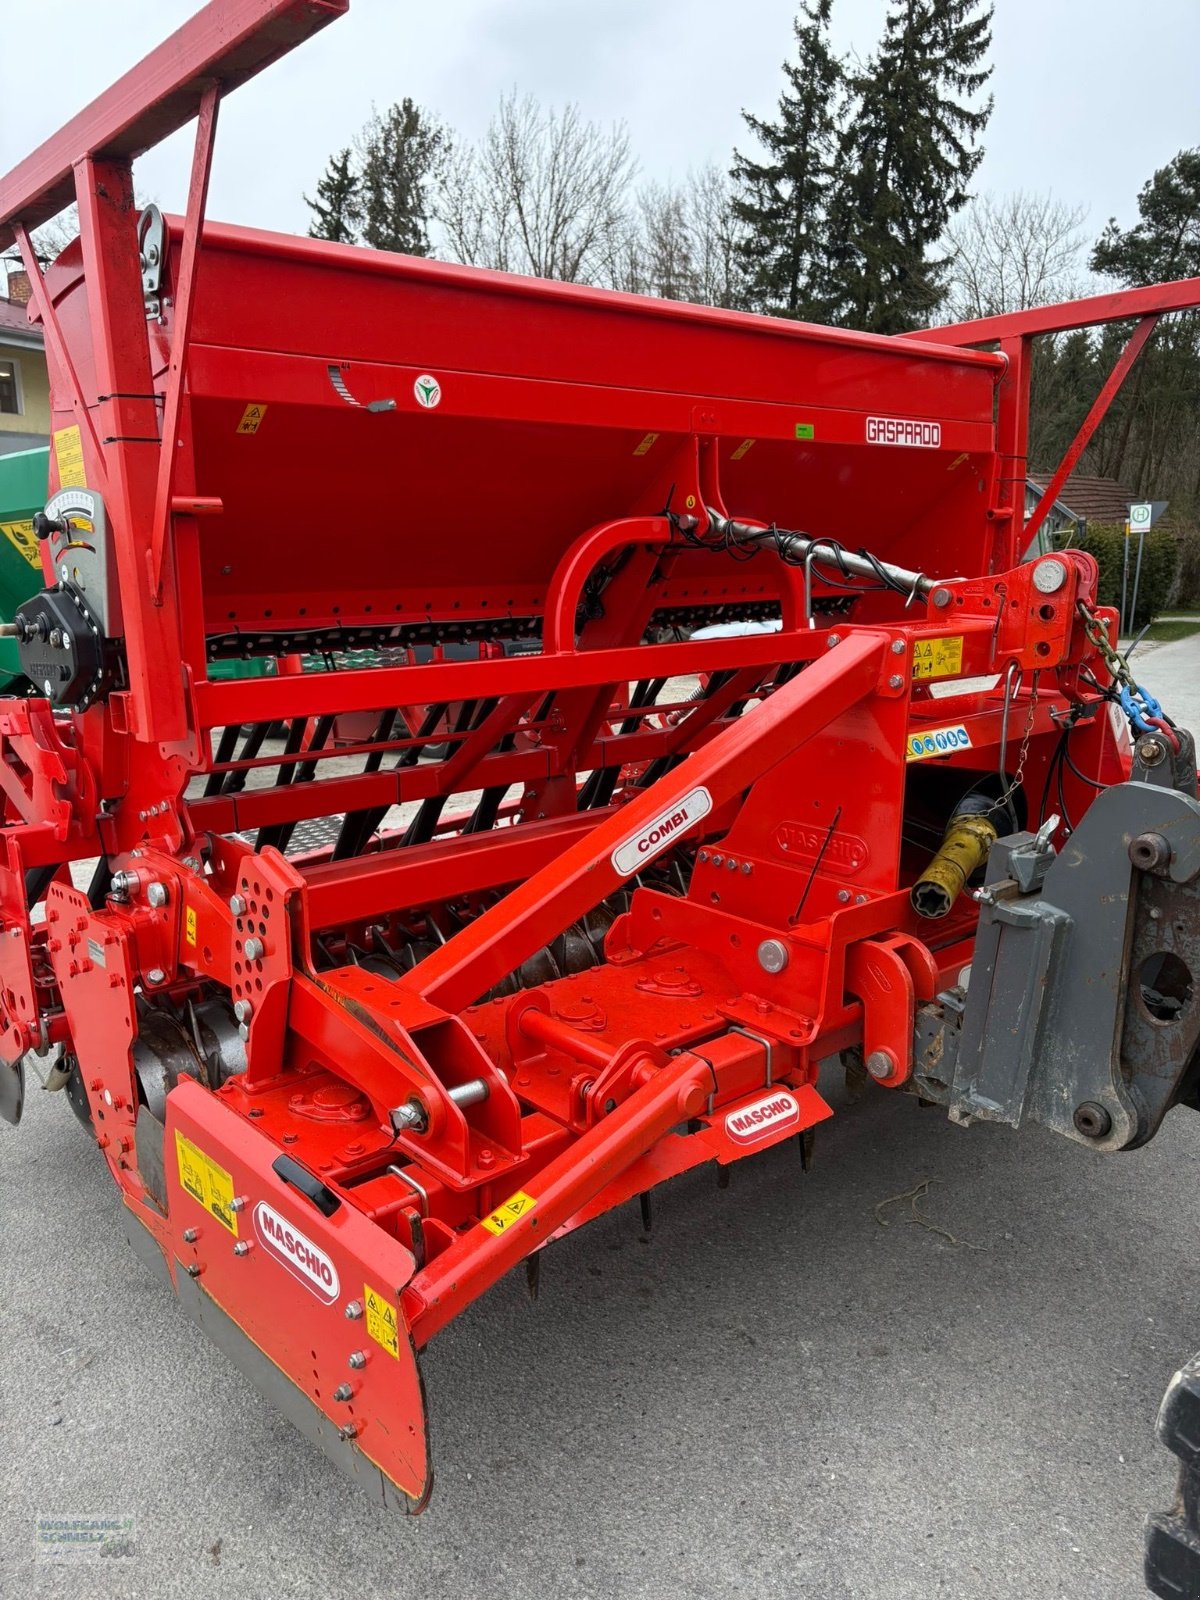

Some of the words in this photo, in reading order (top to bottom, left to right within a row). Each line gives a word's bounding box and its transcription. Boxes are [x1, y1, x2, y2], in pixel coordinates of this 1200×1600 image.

[867, 419, 940, 445] GASPARDO
[637, 808, 689, 853] COMBI
[731, 1098, 792, 1132] MASCHIO
[263, 1211, 333, 1287] MASCHIO
